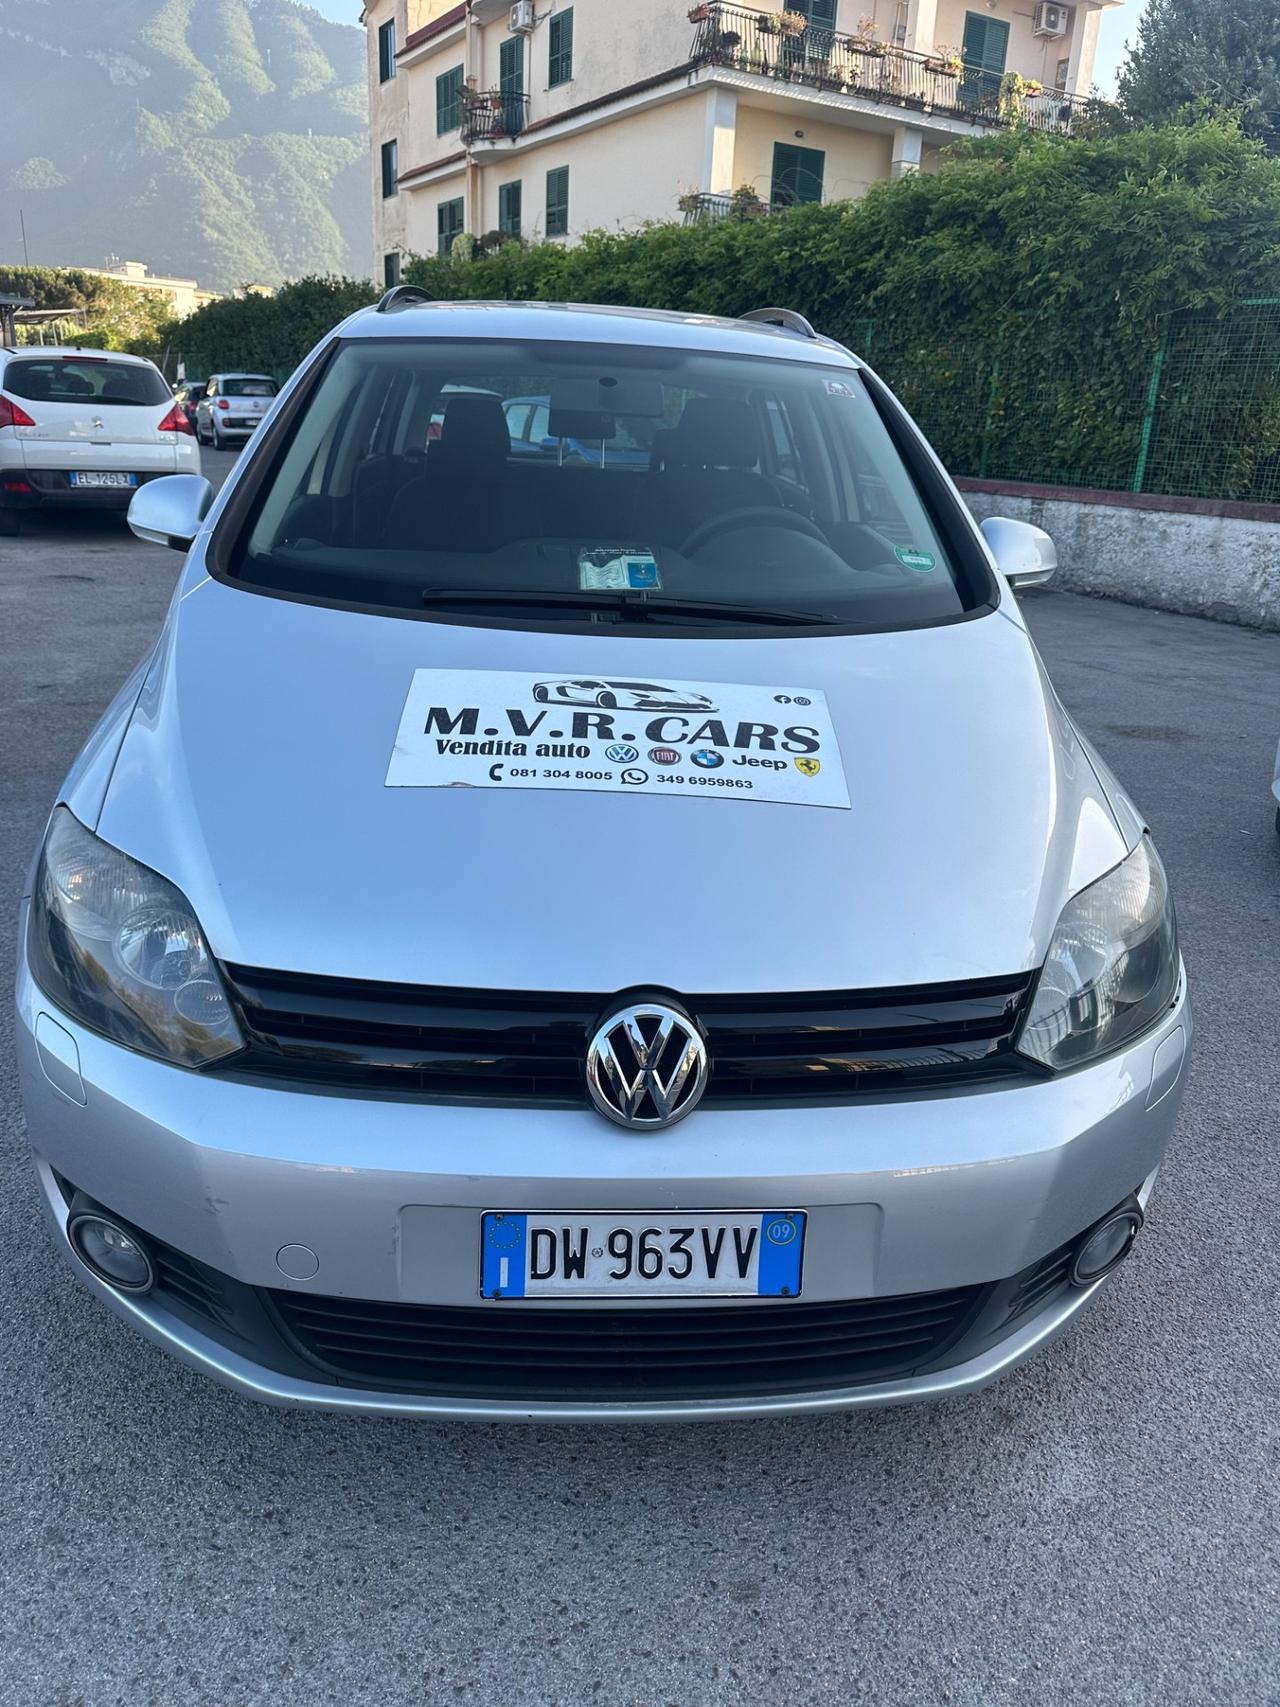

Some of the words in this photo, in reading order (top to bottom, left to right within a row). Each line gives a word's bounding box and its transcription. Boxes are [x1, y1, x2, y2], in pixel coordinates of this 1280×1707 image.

[78, 472, 92, 484] EL
[436, 739, 527, 756] Vendita
[535, 742, 591, 759] auto
[656, 751, 675, 761] FIAT
[732, 755, 788, 771] Jeep
[509, 768, 538, 778] 081
[542, 769, 571, 779] 304
[575, 770, 613, 781] 8005
[656, 774, 685, 784] 349
[688, 776, 754, 789] 6959863
[772, 1225, 791, 1239] 09
[530, 1227, 590, 1280] DW
[607, 1227, 759, 1280] 963VV
[500, 1257, 509, 1288] I
